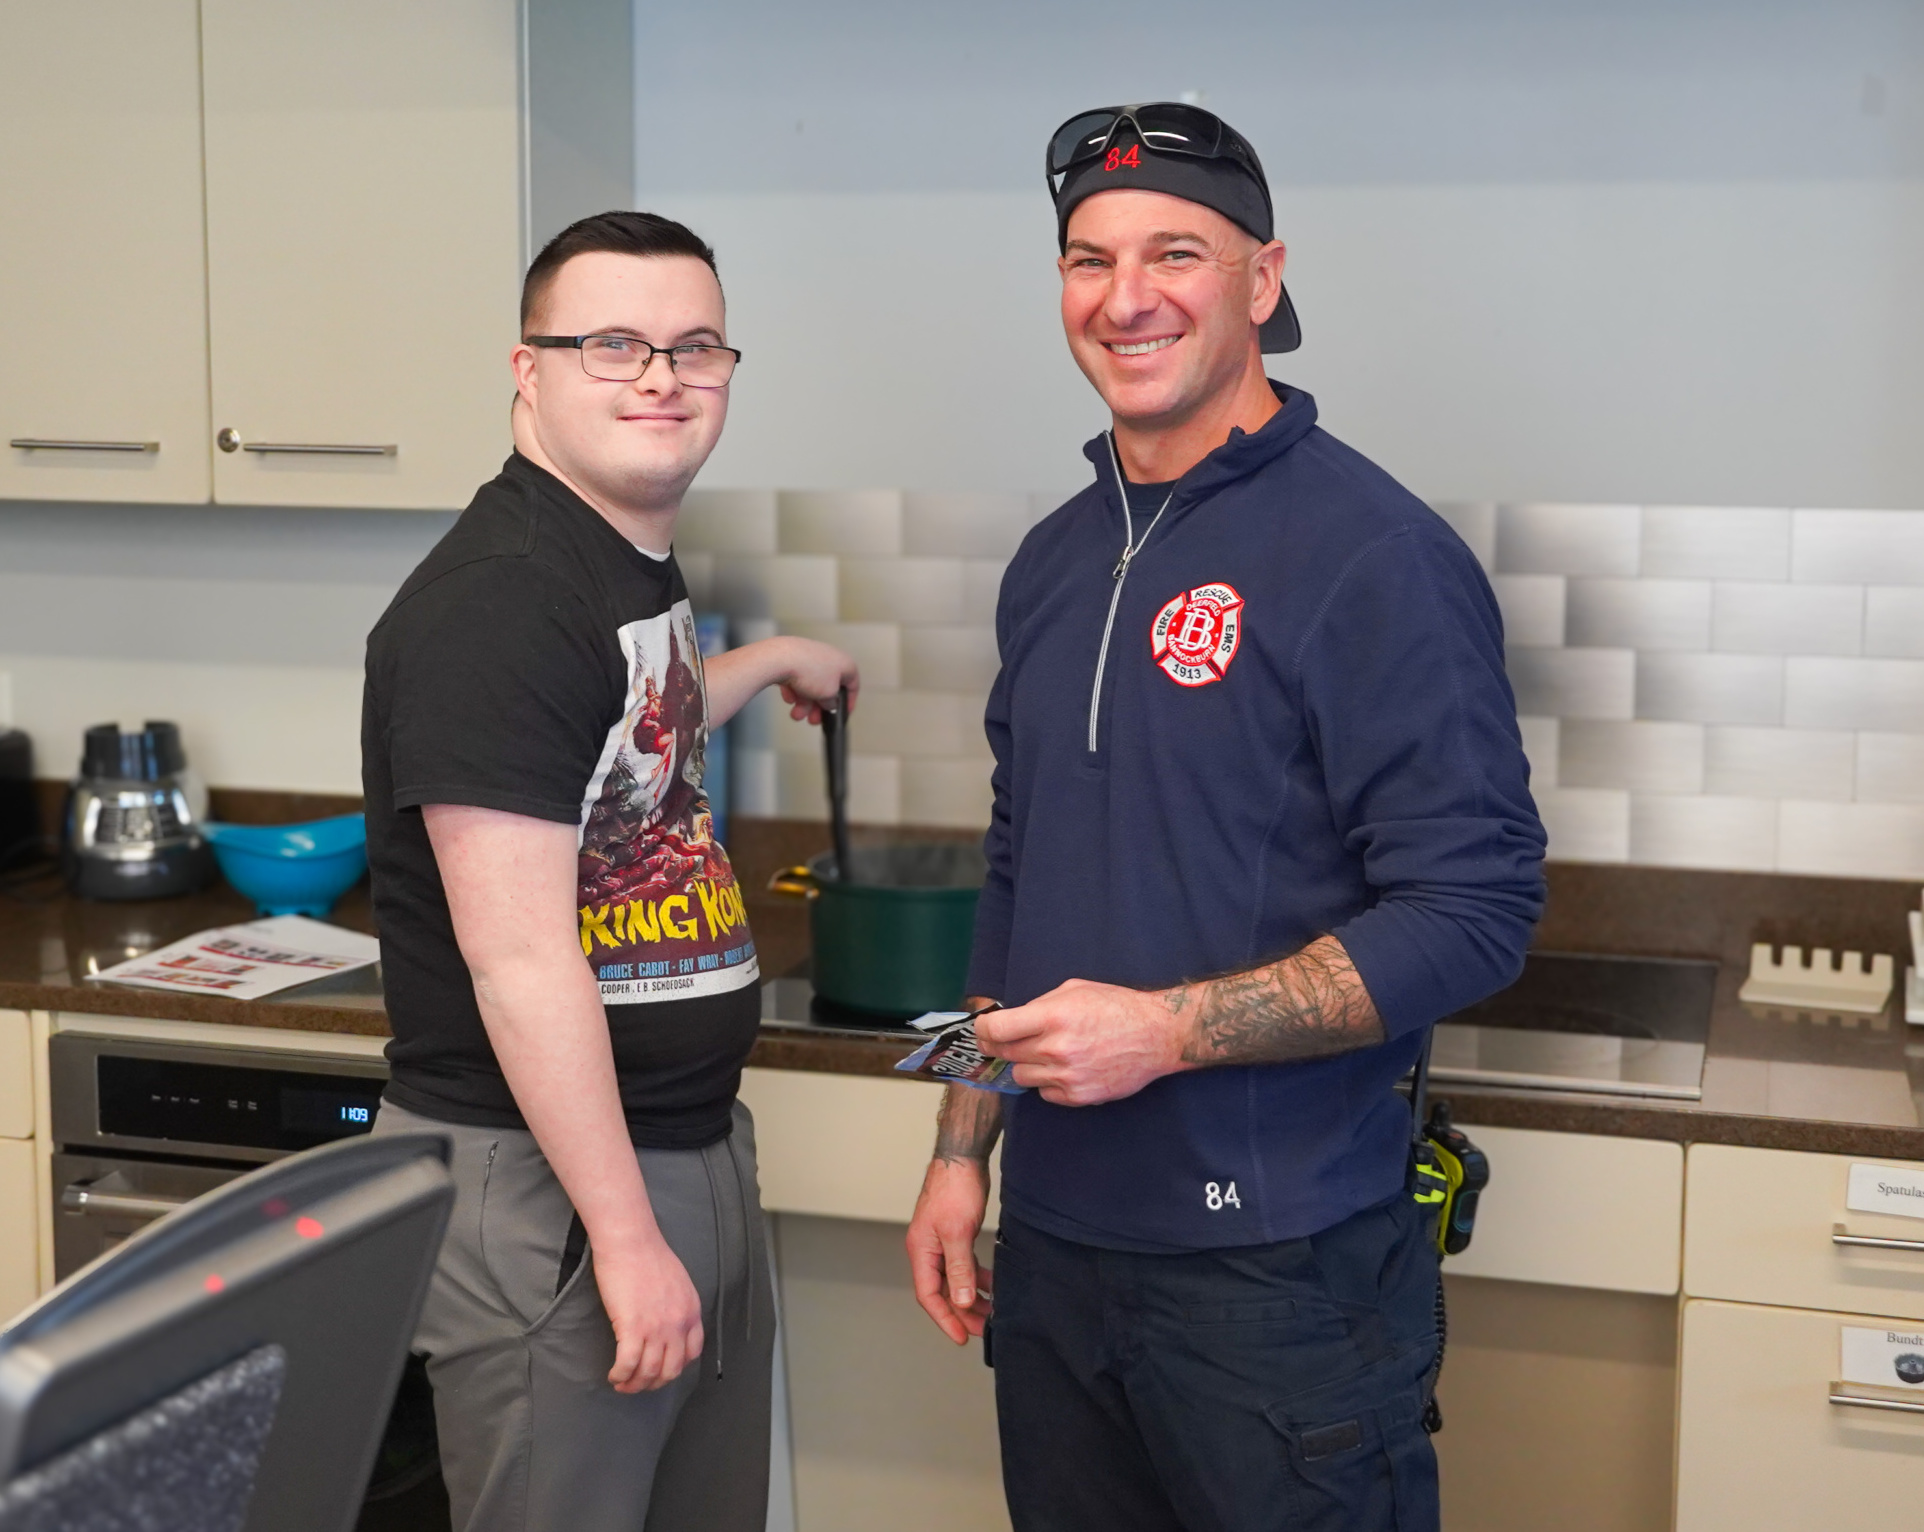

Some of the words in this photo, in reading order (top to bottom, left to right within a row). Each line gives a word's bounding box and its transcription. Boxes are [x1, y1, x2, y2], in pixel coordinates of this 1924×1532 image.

[1104, 143, 1141, 171] 84
[1195, 588, 1232, 604] RESCUE
[1186, 599, 1221, 617] DEERFIELD
[1156, 608, 1175, 636] FIRE
[1168, 634, 1216, 664] BANNOCKBURN
[1221, 624, 1235, 653] EMS
[1172, 663, 1202, 679] 1913
[579, 894, 699, 957] KING
[693, 877, 747, 942] KON
[599, 963, 634, 980] BRUCE
[638, 960, 671, 977] CABOT
[678, 957, 694, 974] FAY
[601, 983, 631, 995] COOPER
[340, 1106, 369, 1122] 11:09
[1204, 1180, 1242, 1211] 84
[1886, 1331, 1924, 1346] Bundt
